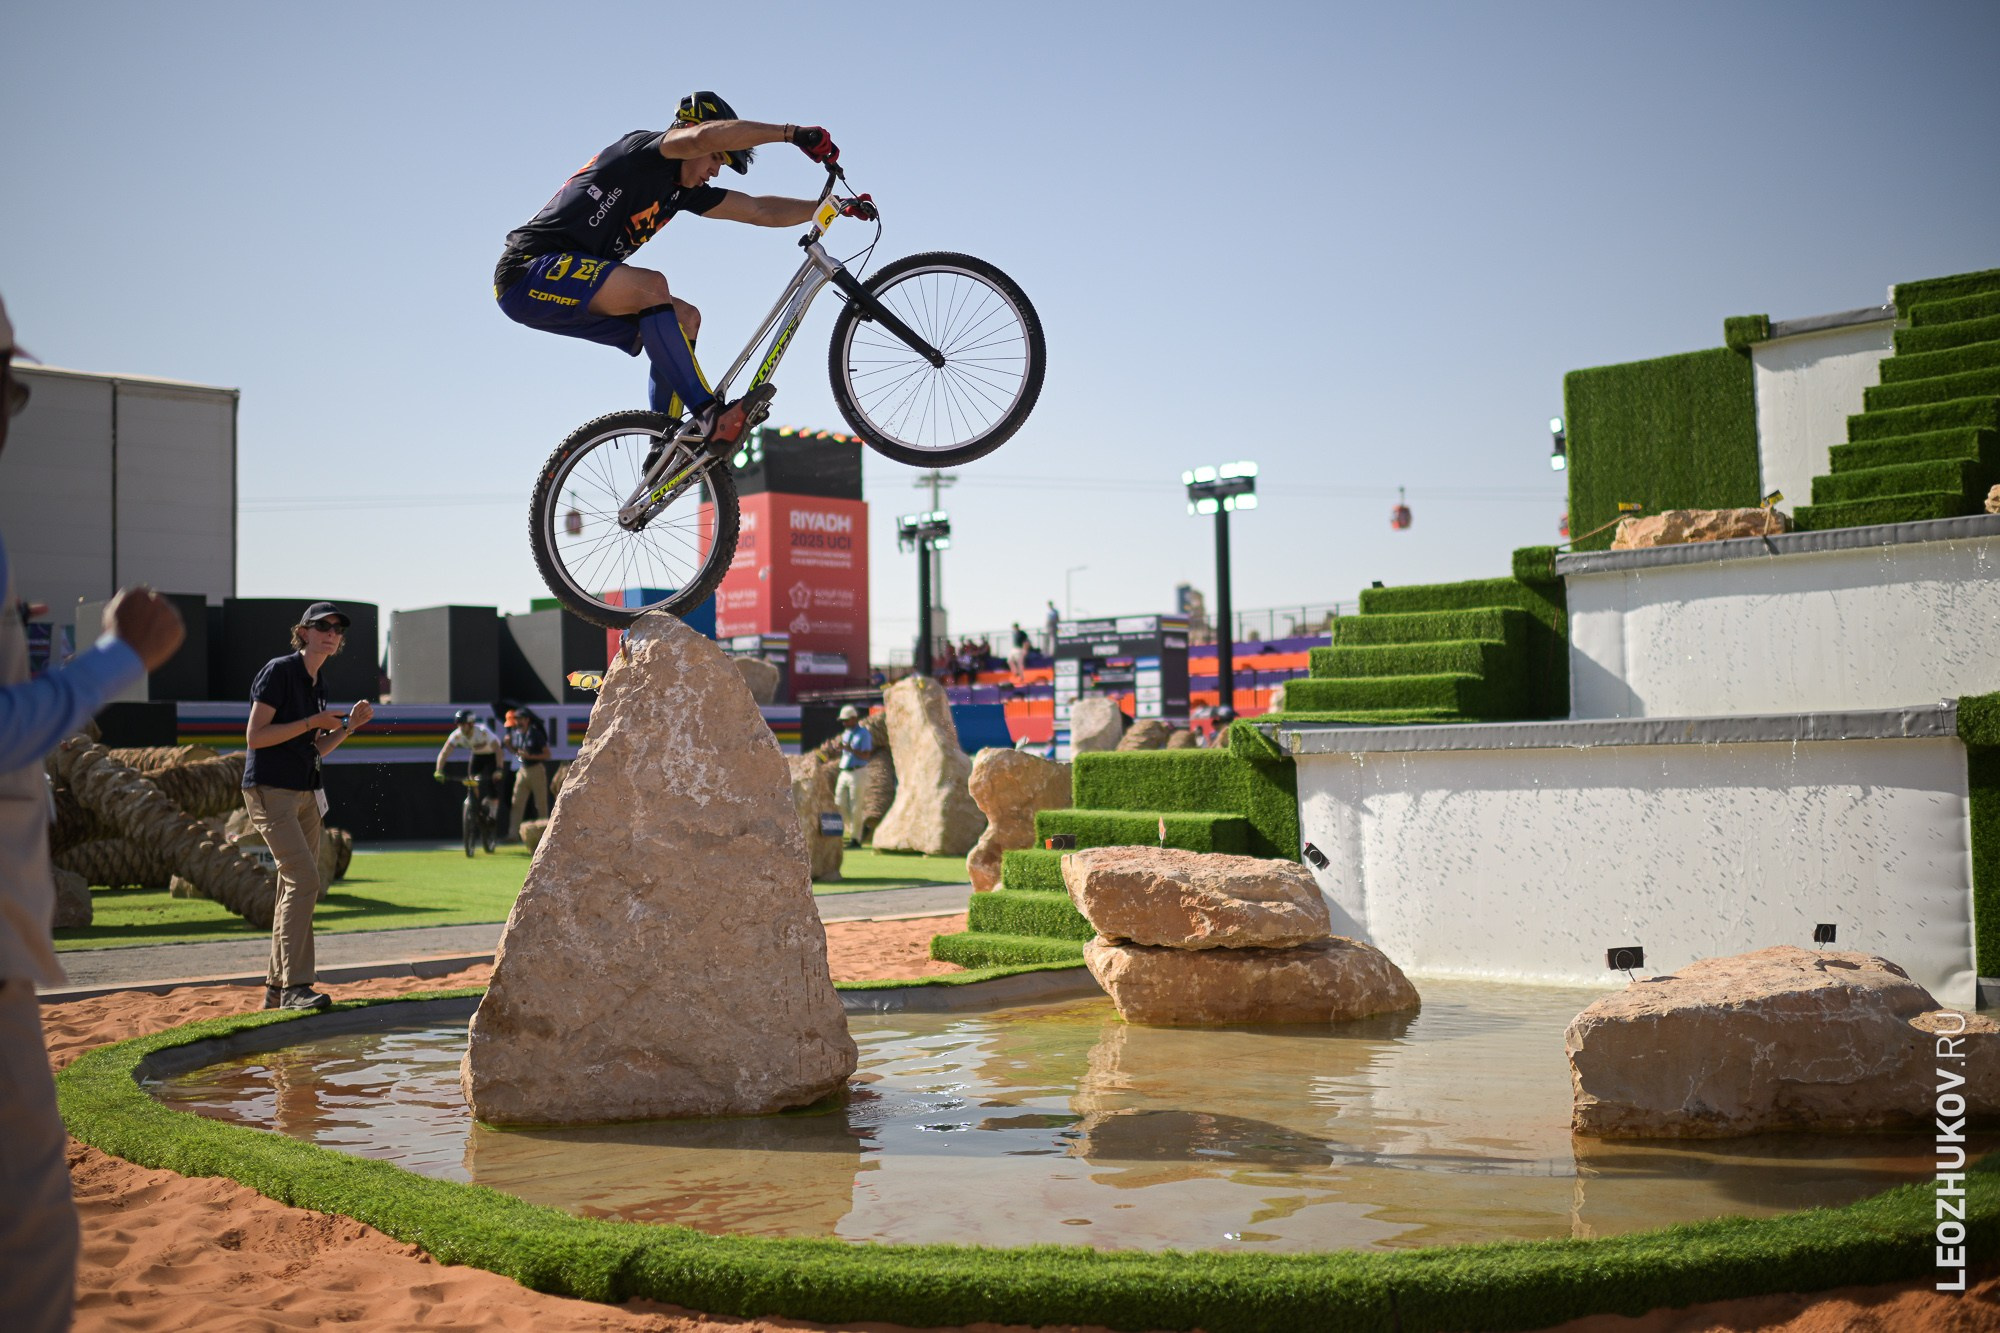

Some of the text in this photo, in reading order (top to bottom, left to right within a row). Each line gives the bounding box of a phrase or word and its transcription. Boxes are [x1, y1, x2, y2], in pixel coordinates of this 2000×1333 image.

[588, 187, 623, 228] Cofidis
[824, 213, 835, 226] 6
[528, 288, 581, 306] COMAS
[790, 510, 852, 533] RIYADH
[790, 532, 852, 549] 2025 UCI
